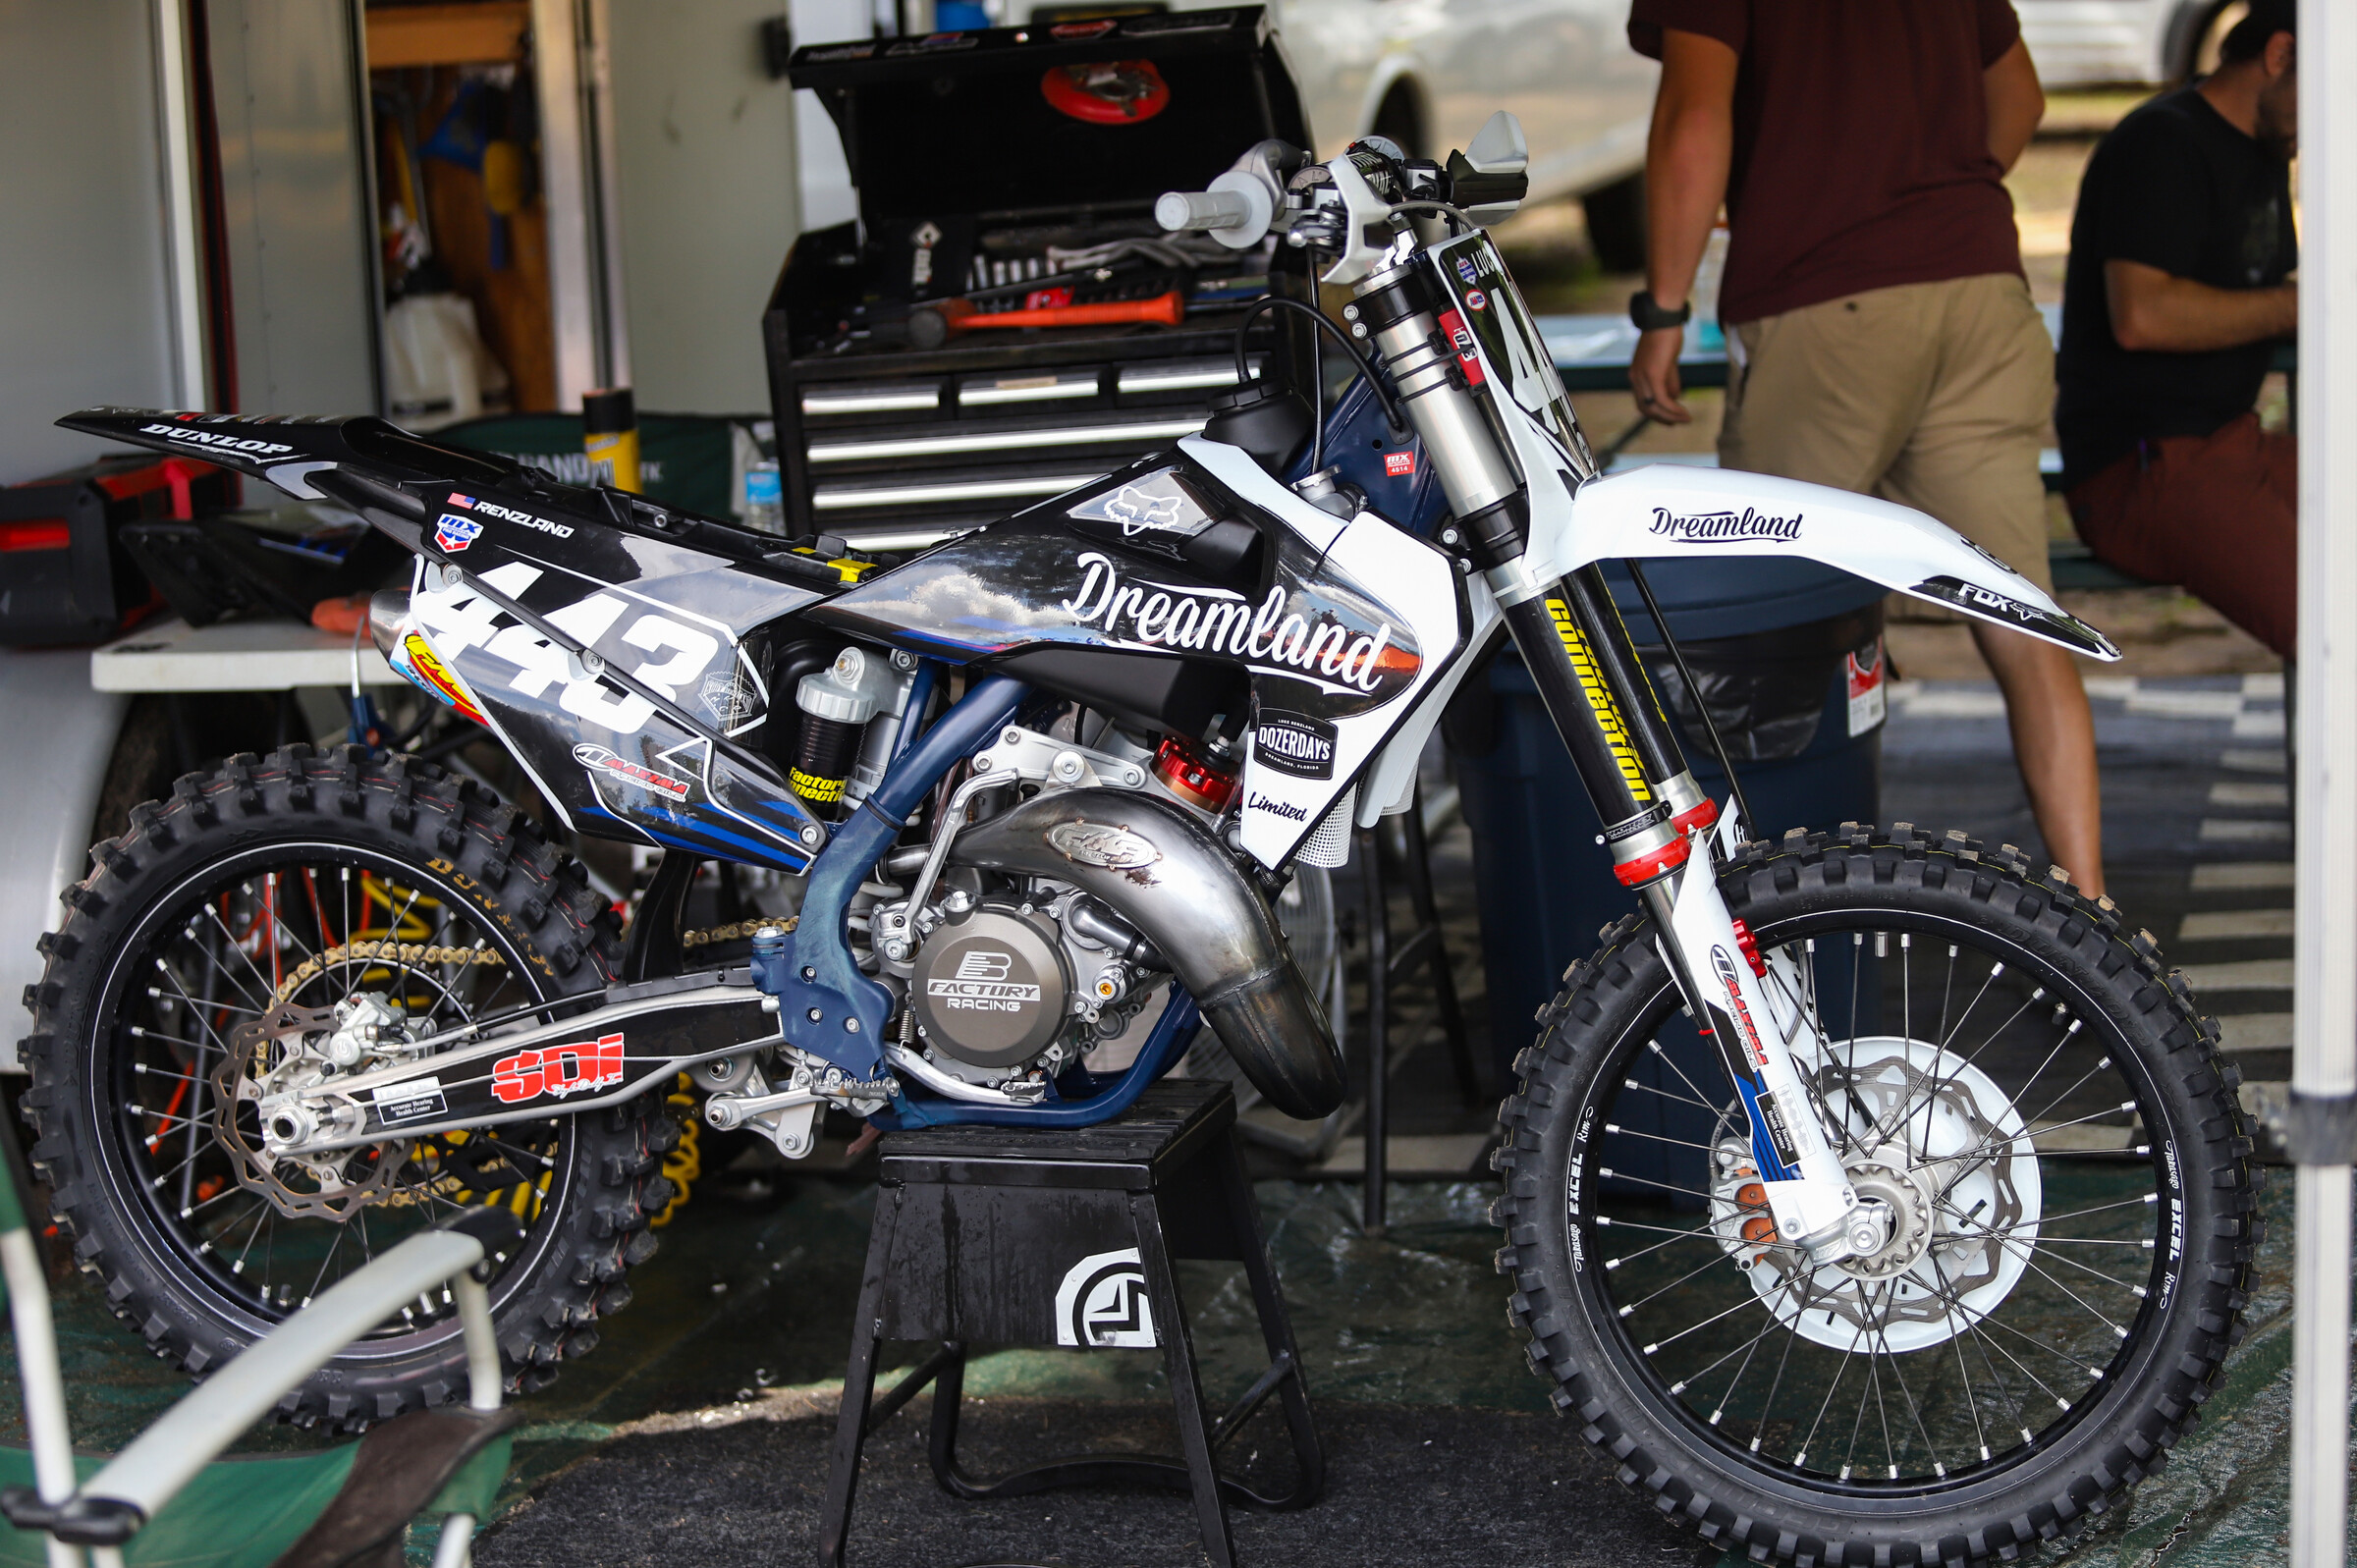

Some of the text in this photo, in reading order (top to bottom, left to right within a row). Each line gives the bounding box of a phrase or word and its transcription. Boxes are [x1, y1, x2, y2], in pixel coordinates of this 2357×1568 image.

[139, 423, 293, 454] DUNLOP
[473, 501, 576, 539] RENZLAND
[1648, 507, 1803, 541] Dreamland
[1957, 582, 2013, 613] FOX
[1062, 552, 1392, 691] Dreamland
[413, 561, 720, 734] 443
[1545, 598, 1651, 801] connection
[1258, 727, 1331, 761] DOZERDAYS
[789, 766, 849, 791] Factory
[1248, 790, 1308, 822] Limited
[928, 982, 1038, 998] FACTORY
[947, 998, 1021, 1012] RACING
[390, 1098, 434, 1112] Accurate Hearing
[395, 1105, 431, 1117] Health Center
[1767, 1109, 1786, 1150] Health Center
[1771, 1103, 1793, 1152] Accurate Hearing
[1568, 1153, 1583, 1216] EXCEL
[2168, 1198, 2183, 1262] EXCEL
